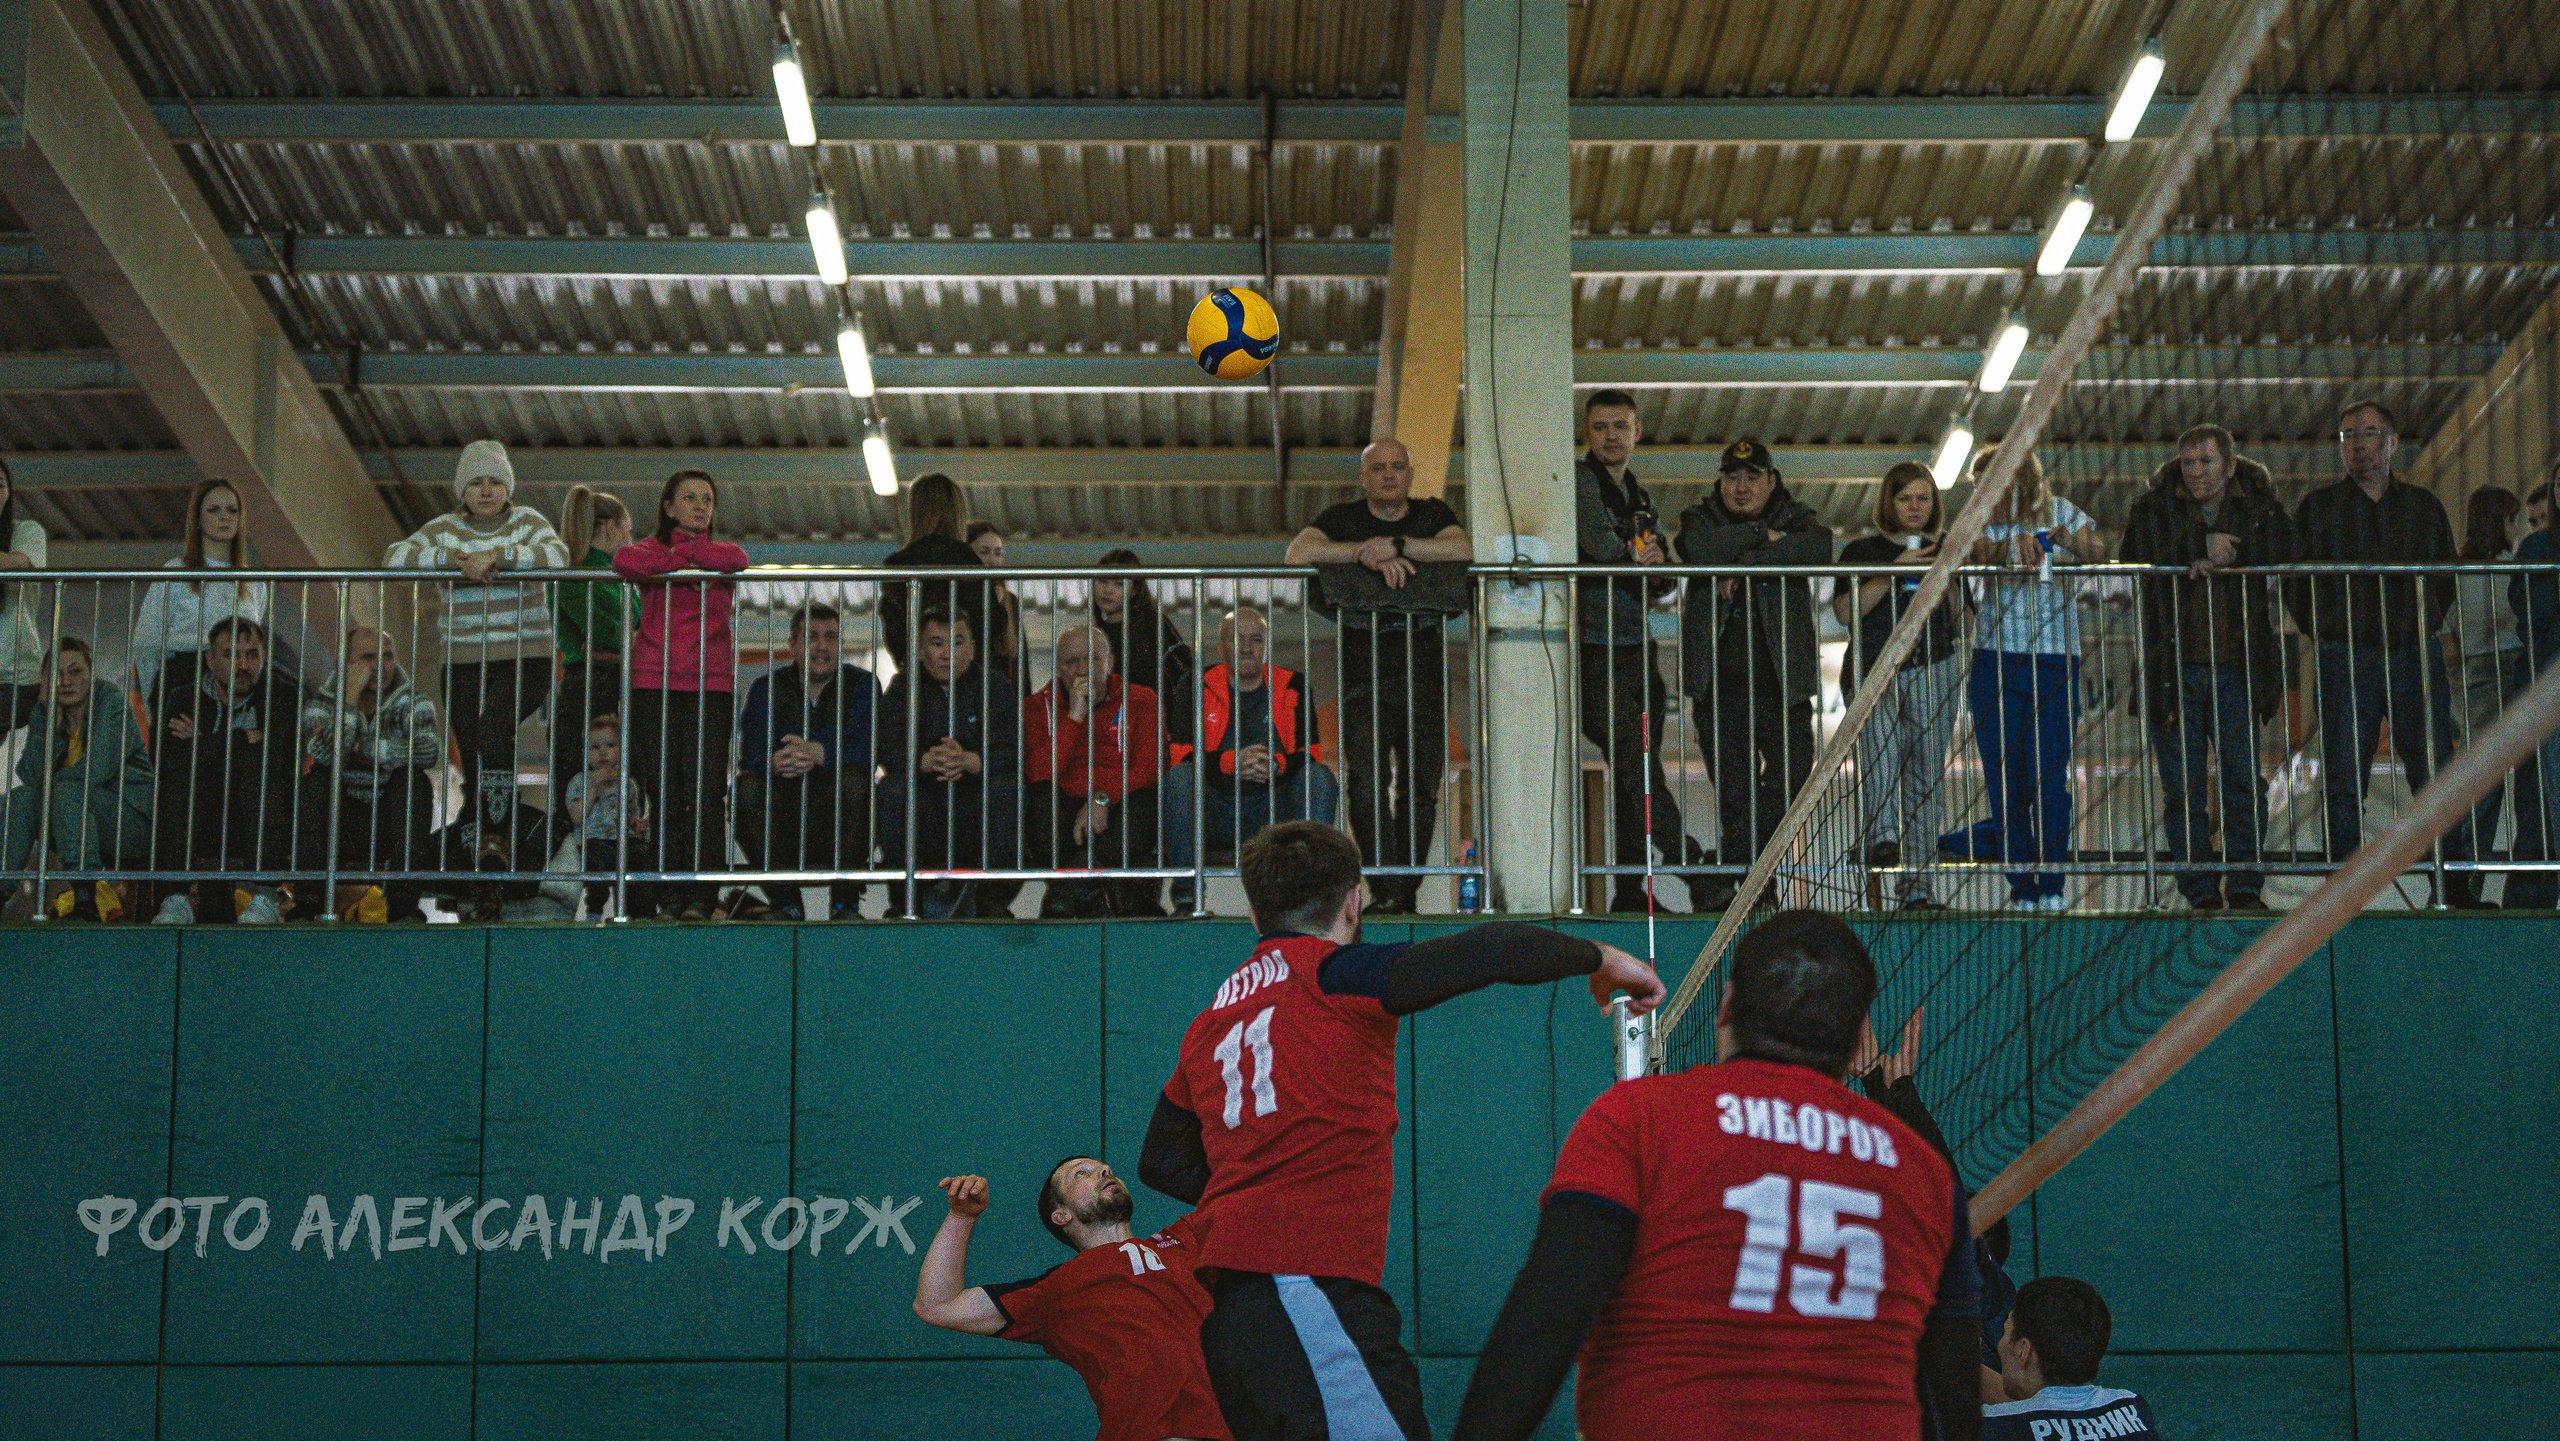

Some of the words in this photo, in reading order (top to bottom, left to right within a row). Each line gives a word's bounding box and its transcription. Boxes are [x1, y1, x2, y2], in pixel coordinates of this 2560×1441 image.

[1212, 949, 1290, 1011] ПЕТРОВ
[1213, 1005, 1279, 1130] 11
[1715, 1092, 1899, 1168] ЗИБОРОВ
[1723, 1172, 1886, 1321] 15
[2029, 1404, 2148, 1441] РУДНИК
